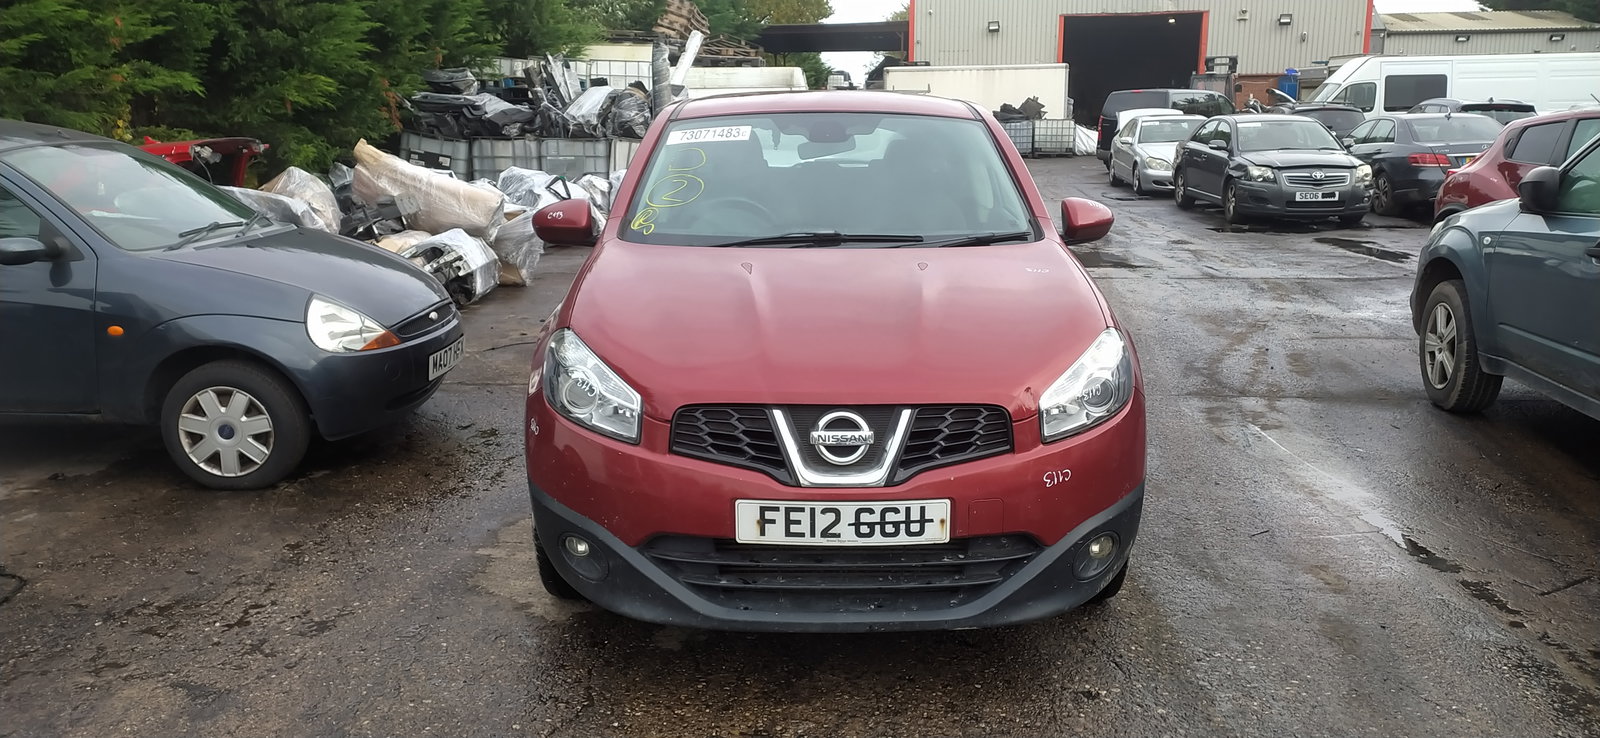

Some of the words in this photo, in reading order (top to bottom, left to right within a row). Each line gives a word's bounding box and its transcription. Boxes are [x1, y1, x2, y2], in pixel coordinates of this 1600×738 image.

[817, 434, 867, 444] NISSAN
[759, 506, 841, 538] FE12
[854, 506, 927, 538] GGU
